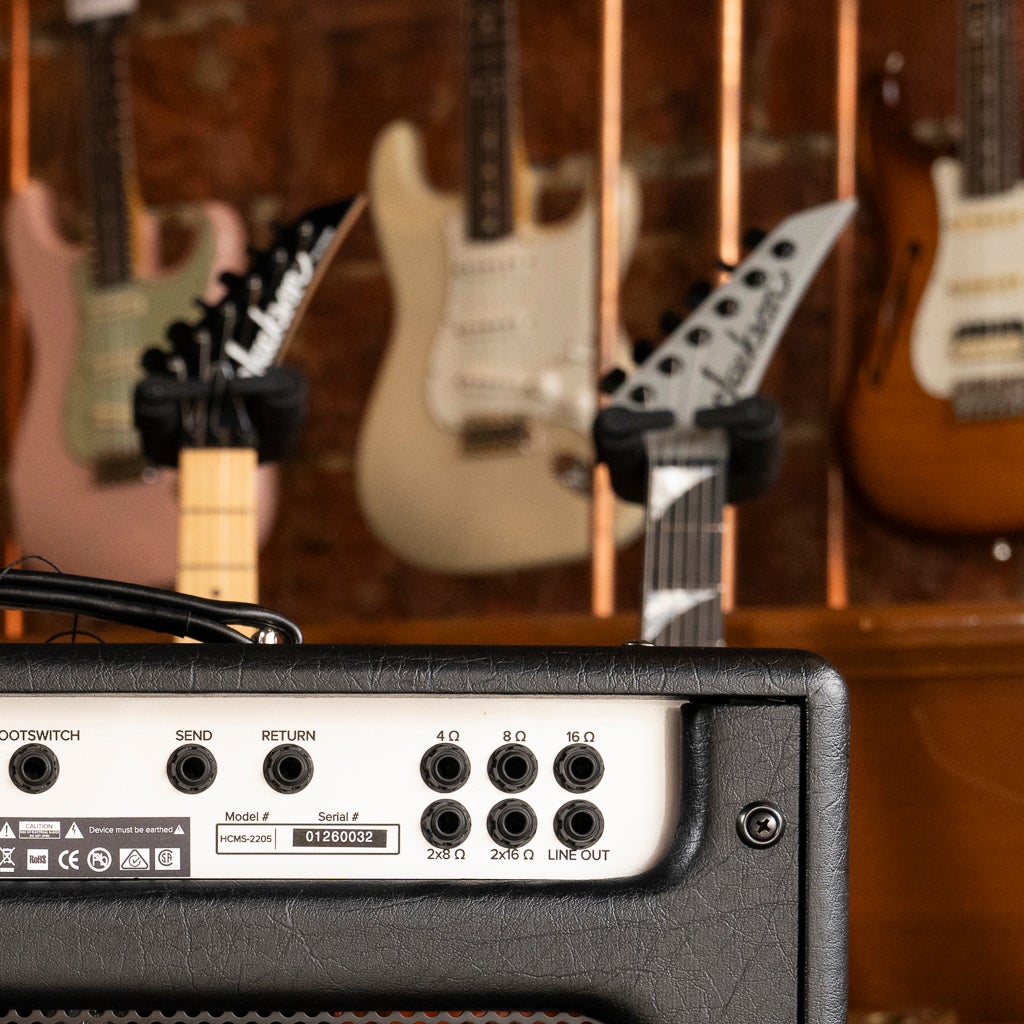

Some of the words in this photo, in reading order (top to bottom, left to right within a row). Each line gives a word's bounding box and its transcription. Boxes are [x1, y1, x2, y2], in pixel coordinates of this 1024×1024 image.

[175, 729, 213, 741] SEND
[261, 729, 316, 741] RETURN
[436, 730, 446, 740] 4
[448, 730, 460, 740] Ω
[502, 730, 512, 740] 8
[514, 730, 527, 740] Ω
[566, 730, 581, 741] 16
[583, 730, 595, 741] Ω
[225, 811, 259, 822] Model
[261, 811, 270, 822] #
[317, 811, 349, 822] Serial
[351, 811, 360, 822] #
[88, 826, 114, 834] Device
[115, 826, 133, 834] must
[134, 826, 145, 834] be
[145, 826, 174, 834] earthed
[219, 834, 273, 843] HCMS-2205
[305, 829, 374, 843] 01260032
[29, 854, 47, 865] RoHS
[426, 848, 451, 860] 2x8
[454, 849, 466, 860] Ω
[490, 849, 520, 860] 2x16
[523, 849, 535, 860] Ω
[548, 849, 577, 861] LINE
[580, 849, 611, 861] OUT
